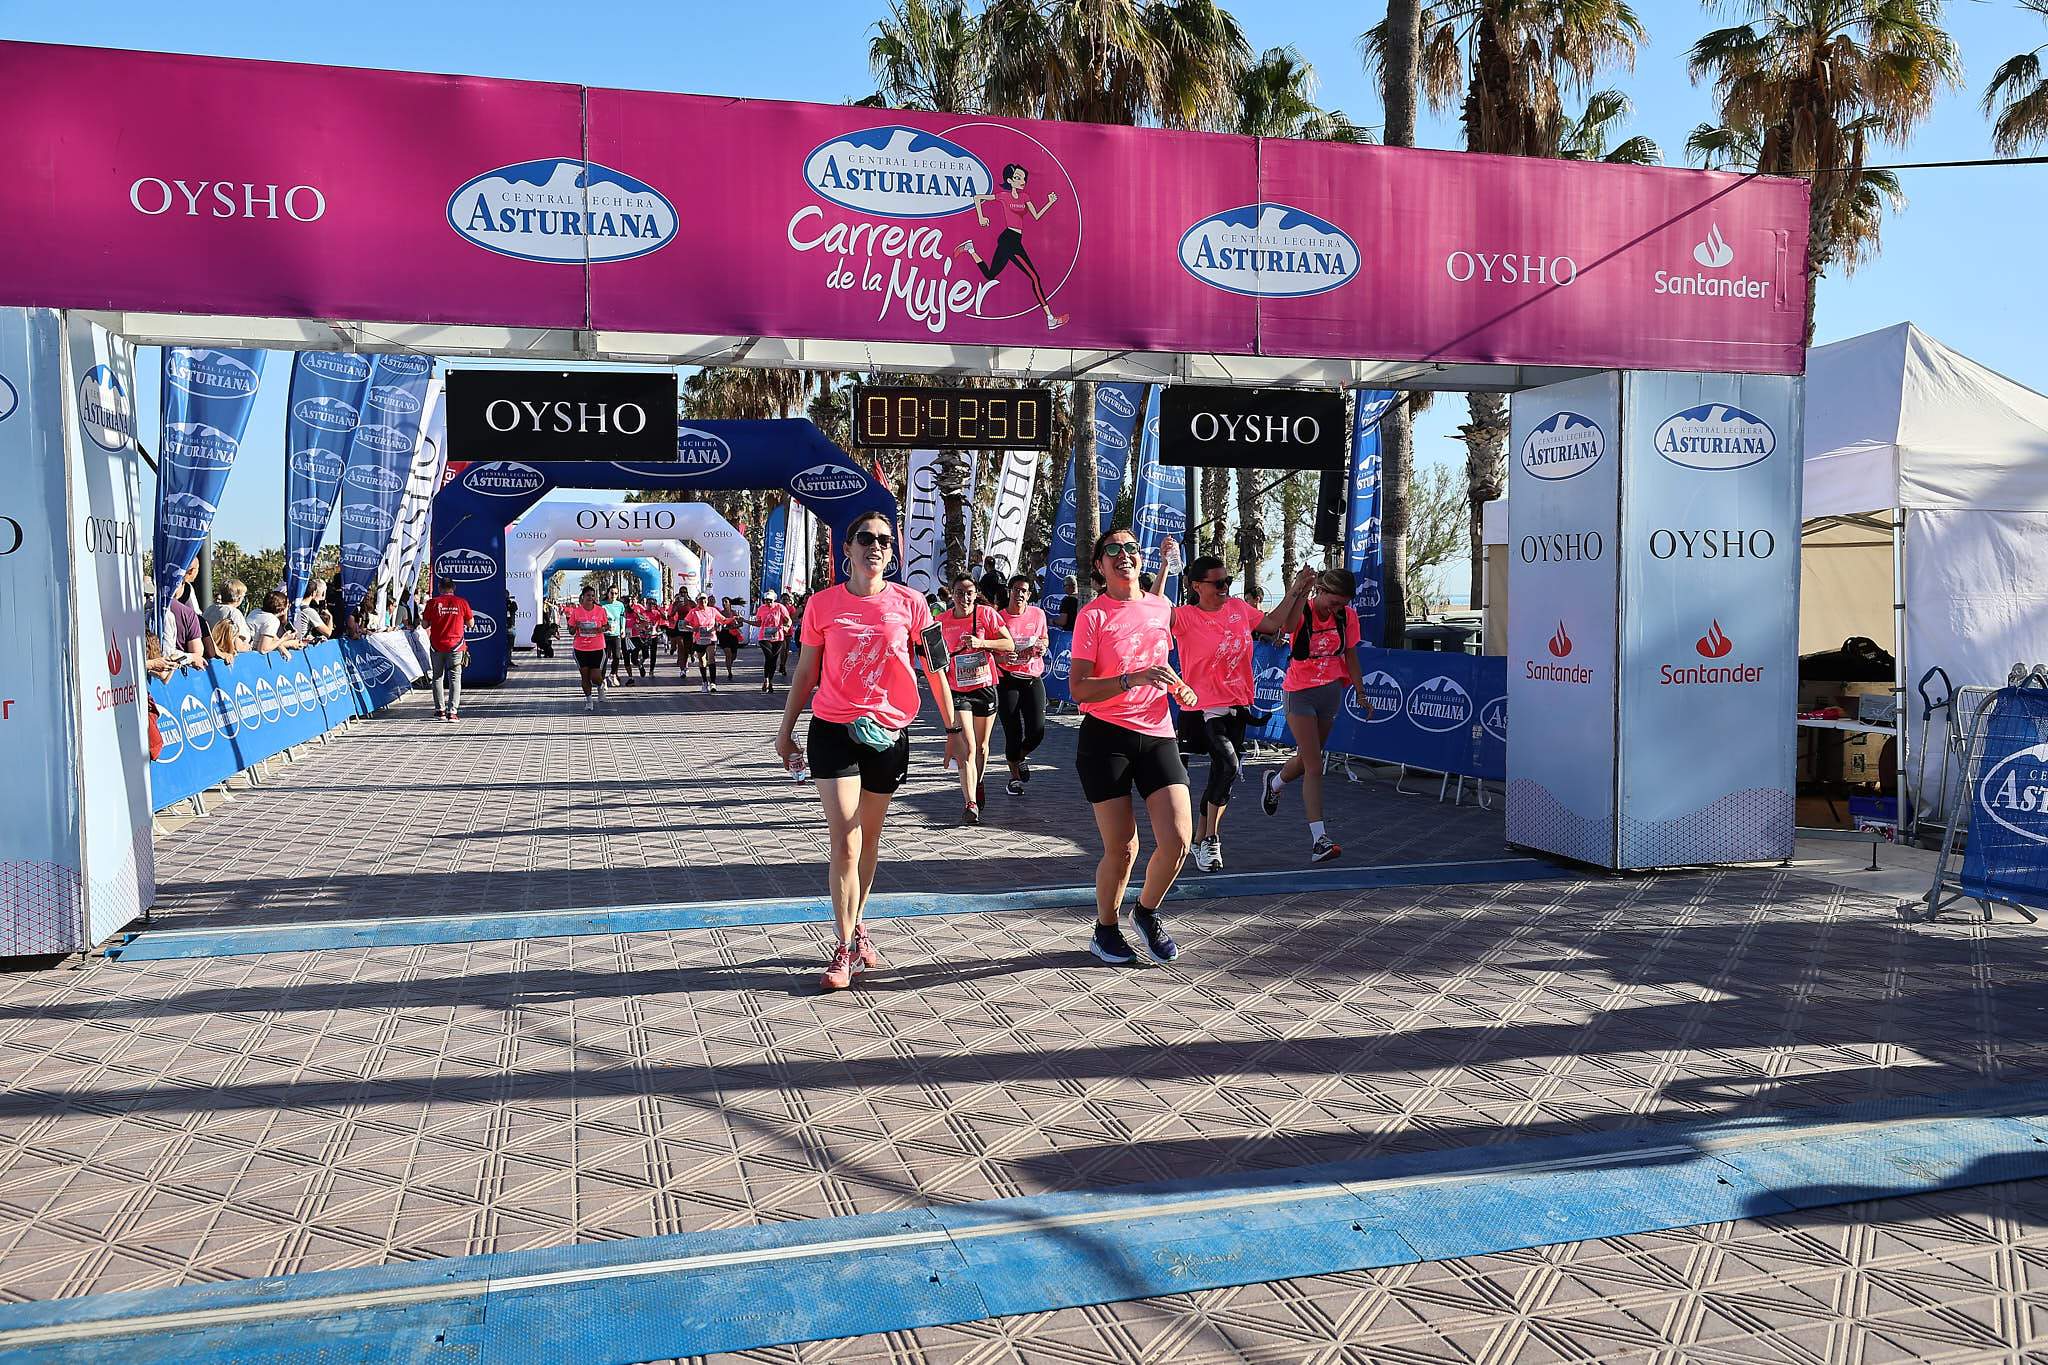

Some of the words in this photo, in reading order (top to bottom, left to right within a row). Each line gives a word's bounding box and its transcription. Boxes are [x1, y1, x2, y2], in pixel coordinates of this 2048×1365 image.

[818, 154, 979, 198] ASTURIANA
[848, 154, 908, 167] CENTRAL
[913, 159, 973, 171] LECHERA
[129, 177, 327, 222] OYSHO
[501, 192, 574, 205] CENTRAL
[466, 192, 662, 239] ASTURIANA
[787, 205, 944, 260] Carrera
[1221, 233, 1278, 245] CENTRAL
[1284, 236, 1341, 248] LECHERA
[1193, 234, 1347, 275] ASTURIANA
[1446, 251, 1577, 286] OYSHO
[826, 260, 856, 290] de
[862, 257, 883, 292] la
[877, 256, 1001, 333] Mujer
[1654, 270, 1769, 299] Santander
[170, 358, 251, 391] ASTURIANA
[305, 353, 367, 378] ASTURIANA
[83, 388, 129, 435] ASTURIANA
[485, 399, 647, 435] OYSHO
[1099, 390, 1131, 416] ASTURIANA
[867, 396, 1037, 440] 00:42:50
[1190, 412, 1321, 445] OYSHO
[1681, 426, 1721, 435] CENTRAL
[1723, 426, 1764, 435] LECHERA
[1538, 434, 1565, 445] CENTRAL
[1566, 429, 1596, 442] LECHERA
[1662, 427, 1767, 454] ASTURIANA
[1526, 440, 1598, 467] ASTURIANA
[468, 473, 538, 488] ASTURIANA
[796, 478, 862, 491] ASTURIANA
[576, 509, 676, 530] OYSHO
[906, 465, 939, 594] OYSHO
[85, 515, 136, 556] OYSHO
[1520, 531, 1603, 564] OYSHO
[1649, 528, 1775, 560] OYSHO
[437, 561, 493, 574] ASTURIANA
[1526, 660, 1593, 684] Santander
[1660, 663, 1764, 685] Santander
[1409, 693, 1464, 721] ASTURIANA
